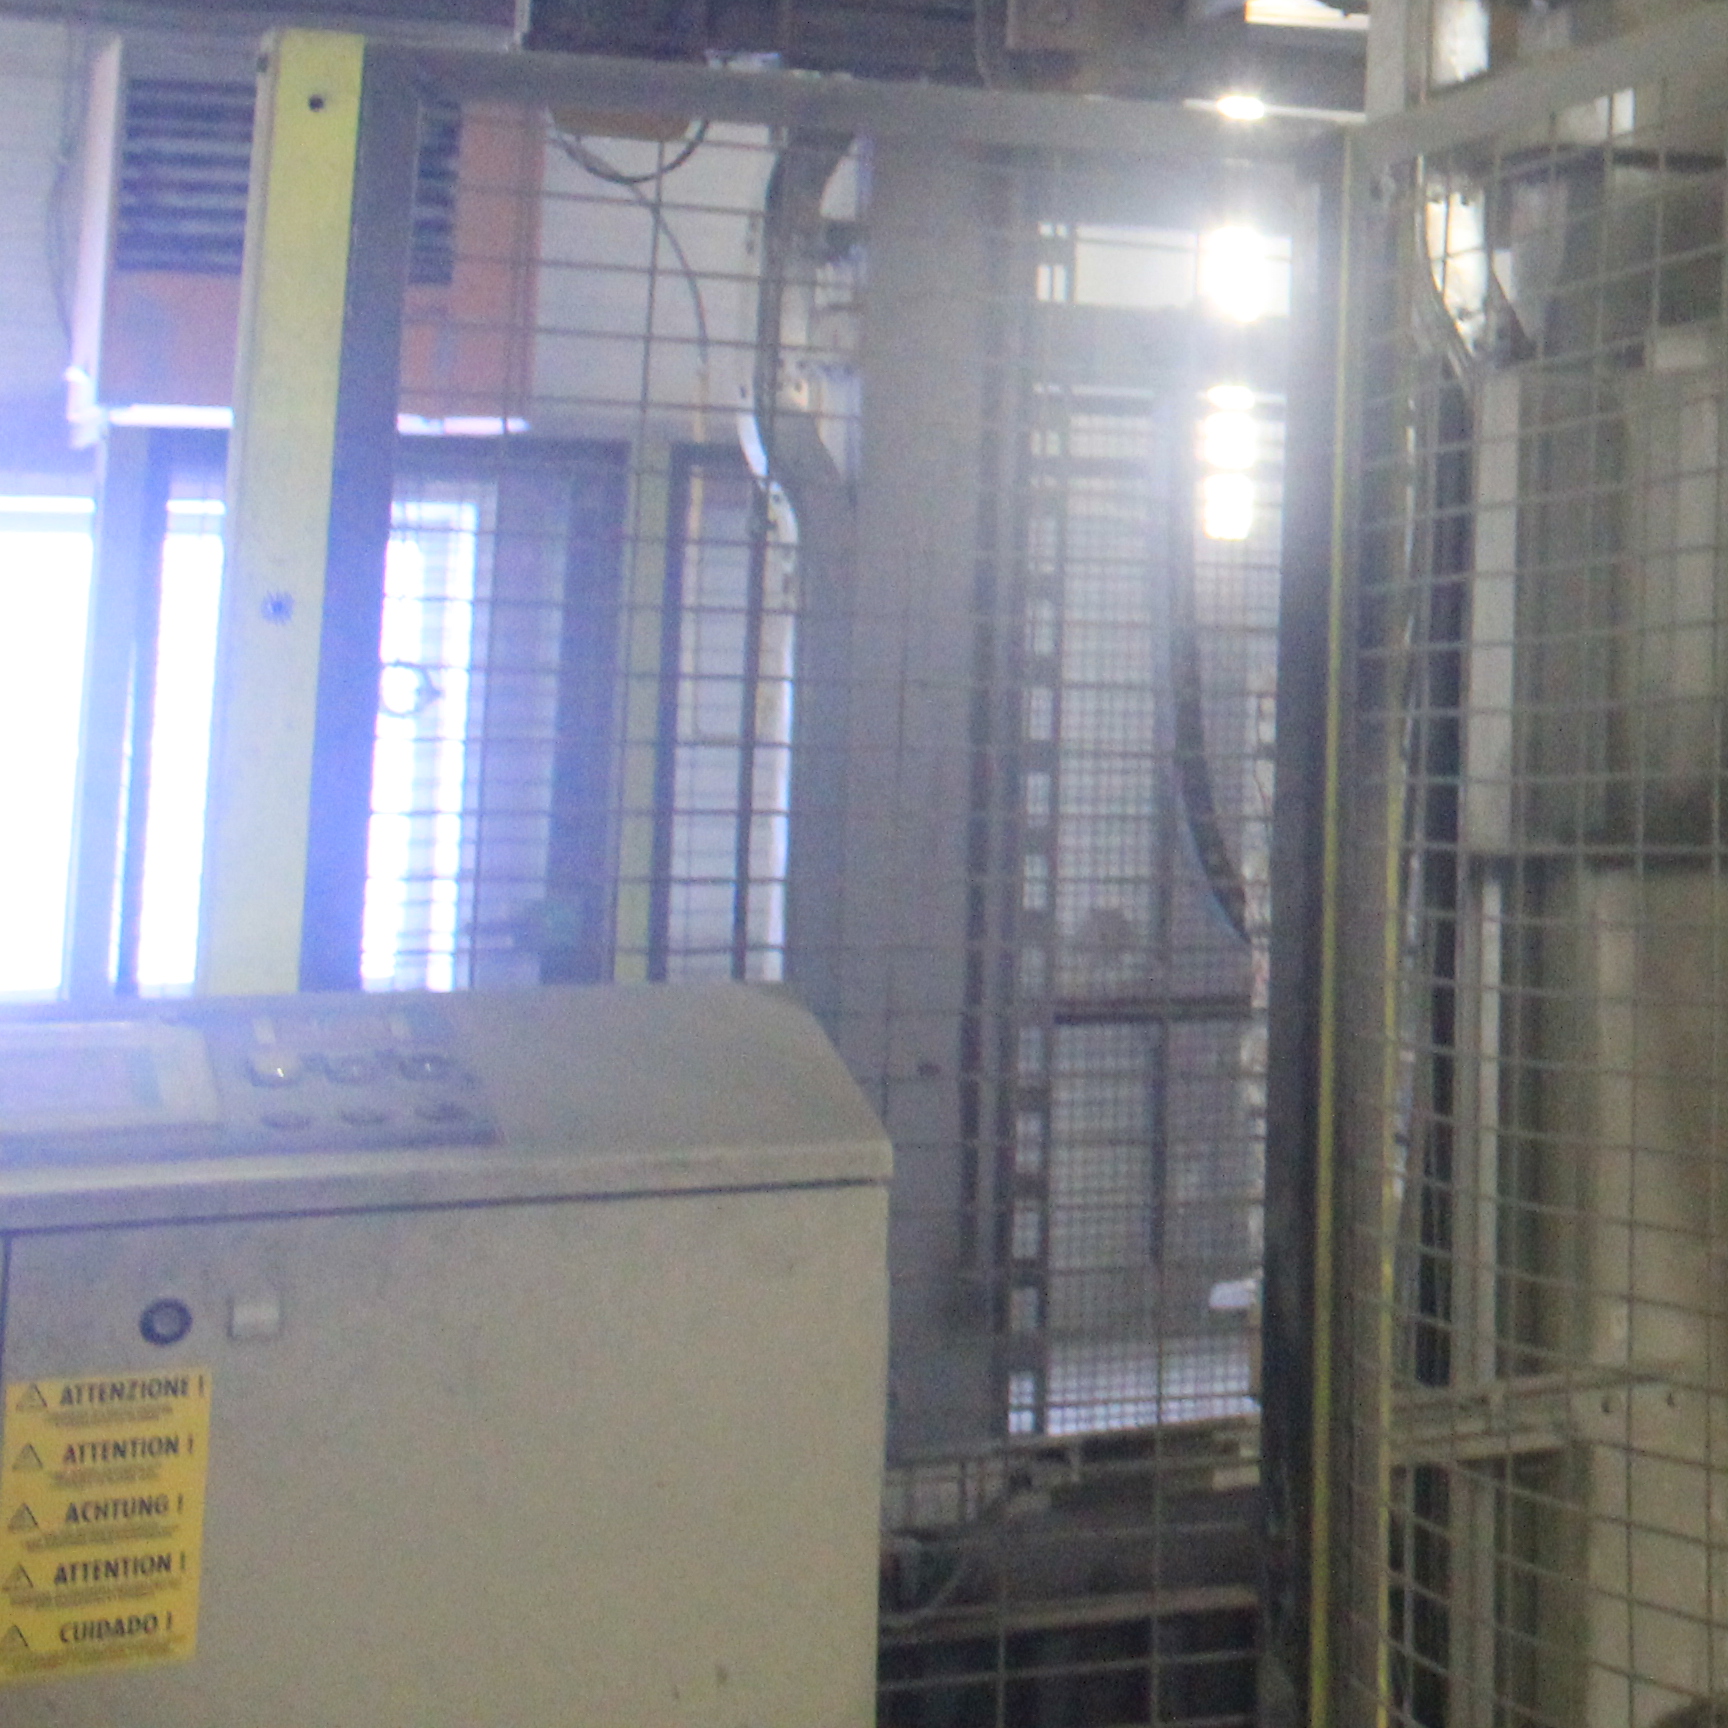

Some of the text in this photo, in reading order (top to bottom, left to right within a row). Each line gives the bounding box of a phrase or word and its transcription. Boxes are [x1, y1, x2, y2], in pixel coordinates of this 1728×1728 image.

[60, 1377, 189, 1406] ATTENZIONE
[64, 1435, 179, 1464] ATTENTION
[66, 1494, 169, 1524] ACHTUNG
[54, 1553, 172, 1585] ATTENTION
[59, 1612, 159, 1644] CUIDADO
